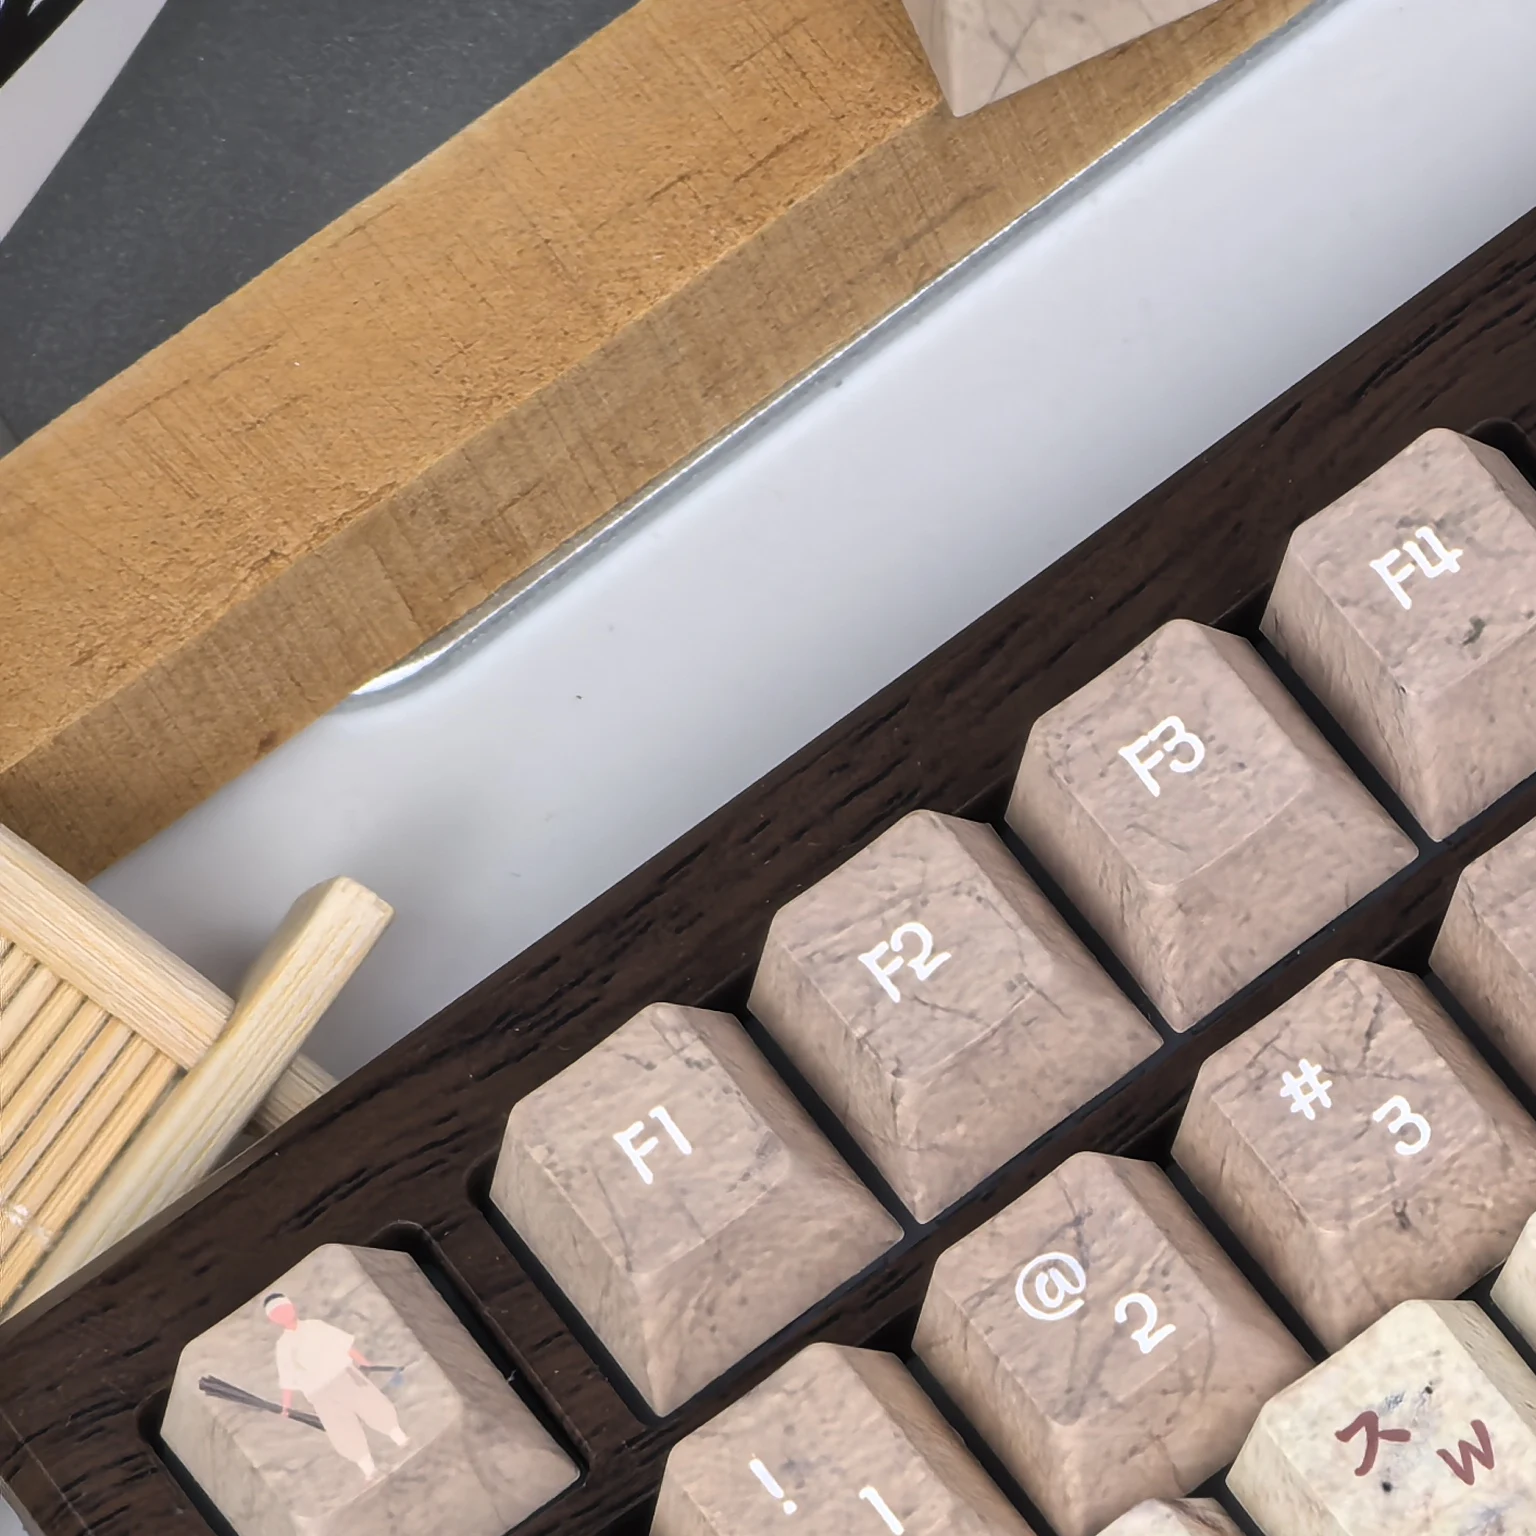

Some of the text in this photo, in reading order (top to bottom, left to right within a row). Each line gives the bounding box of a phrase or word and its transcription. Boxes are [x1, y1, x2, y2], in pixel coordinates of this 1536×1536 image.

[1368, 525, 1464, 611] F4
[1117, 715, 1206, 798] F3
[857, 921, 953, 1004] F2
[612, 1104, 693, 1186] F1
[1371, 1094, 1432, 1160] 3
[1014, 1251, 1177, 1355] @ 2
[1438, 1421, 1495, 1486] W
[858, 1484, 905, 1536] 1
